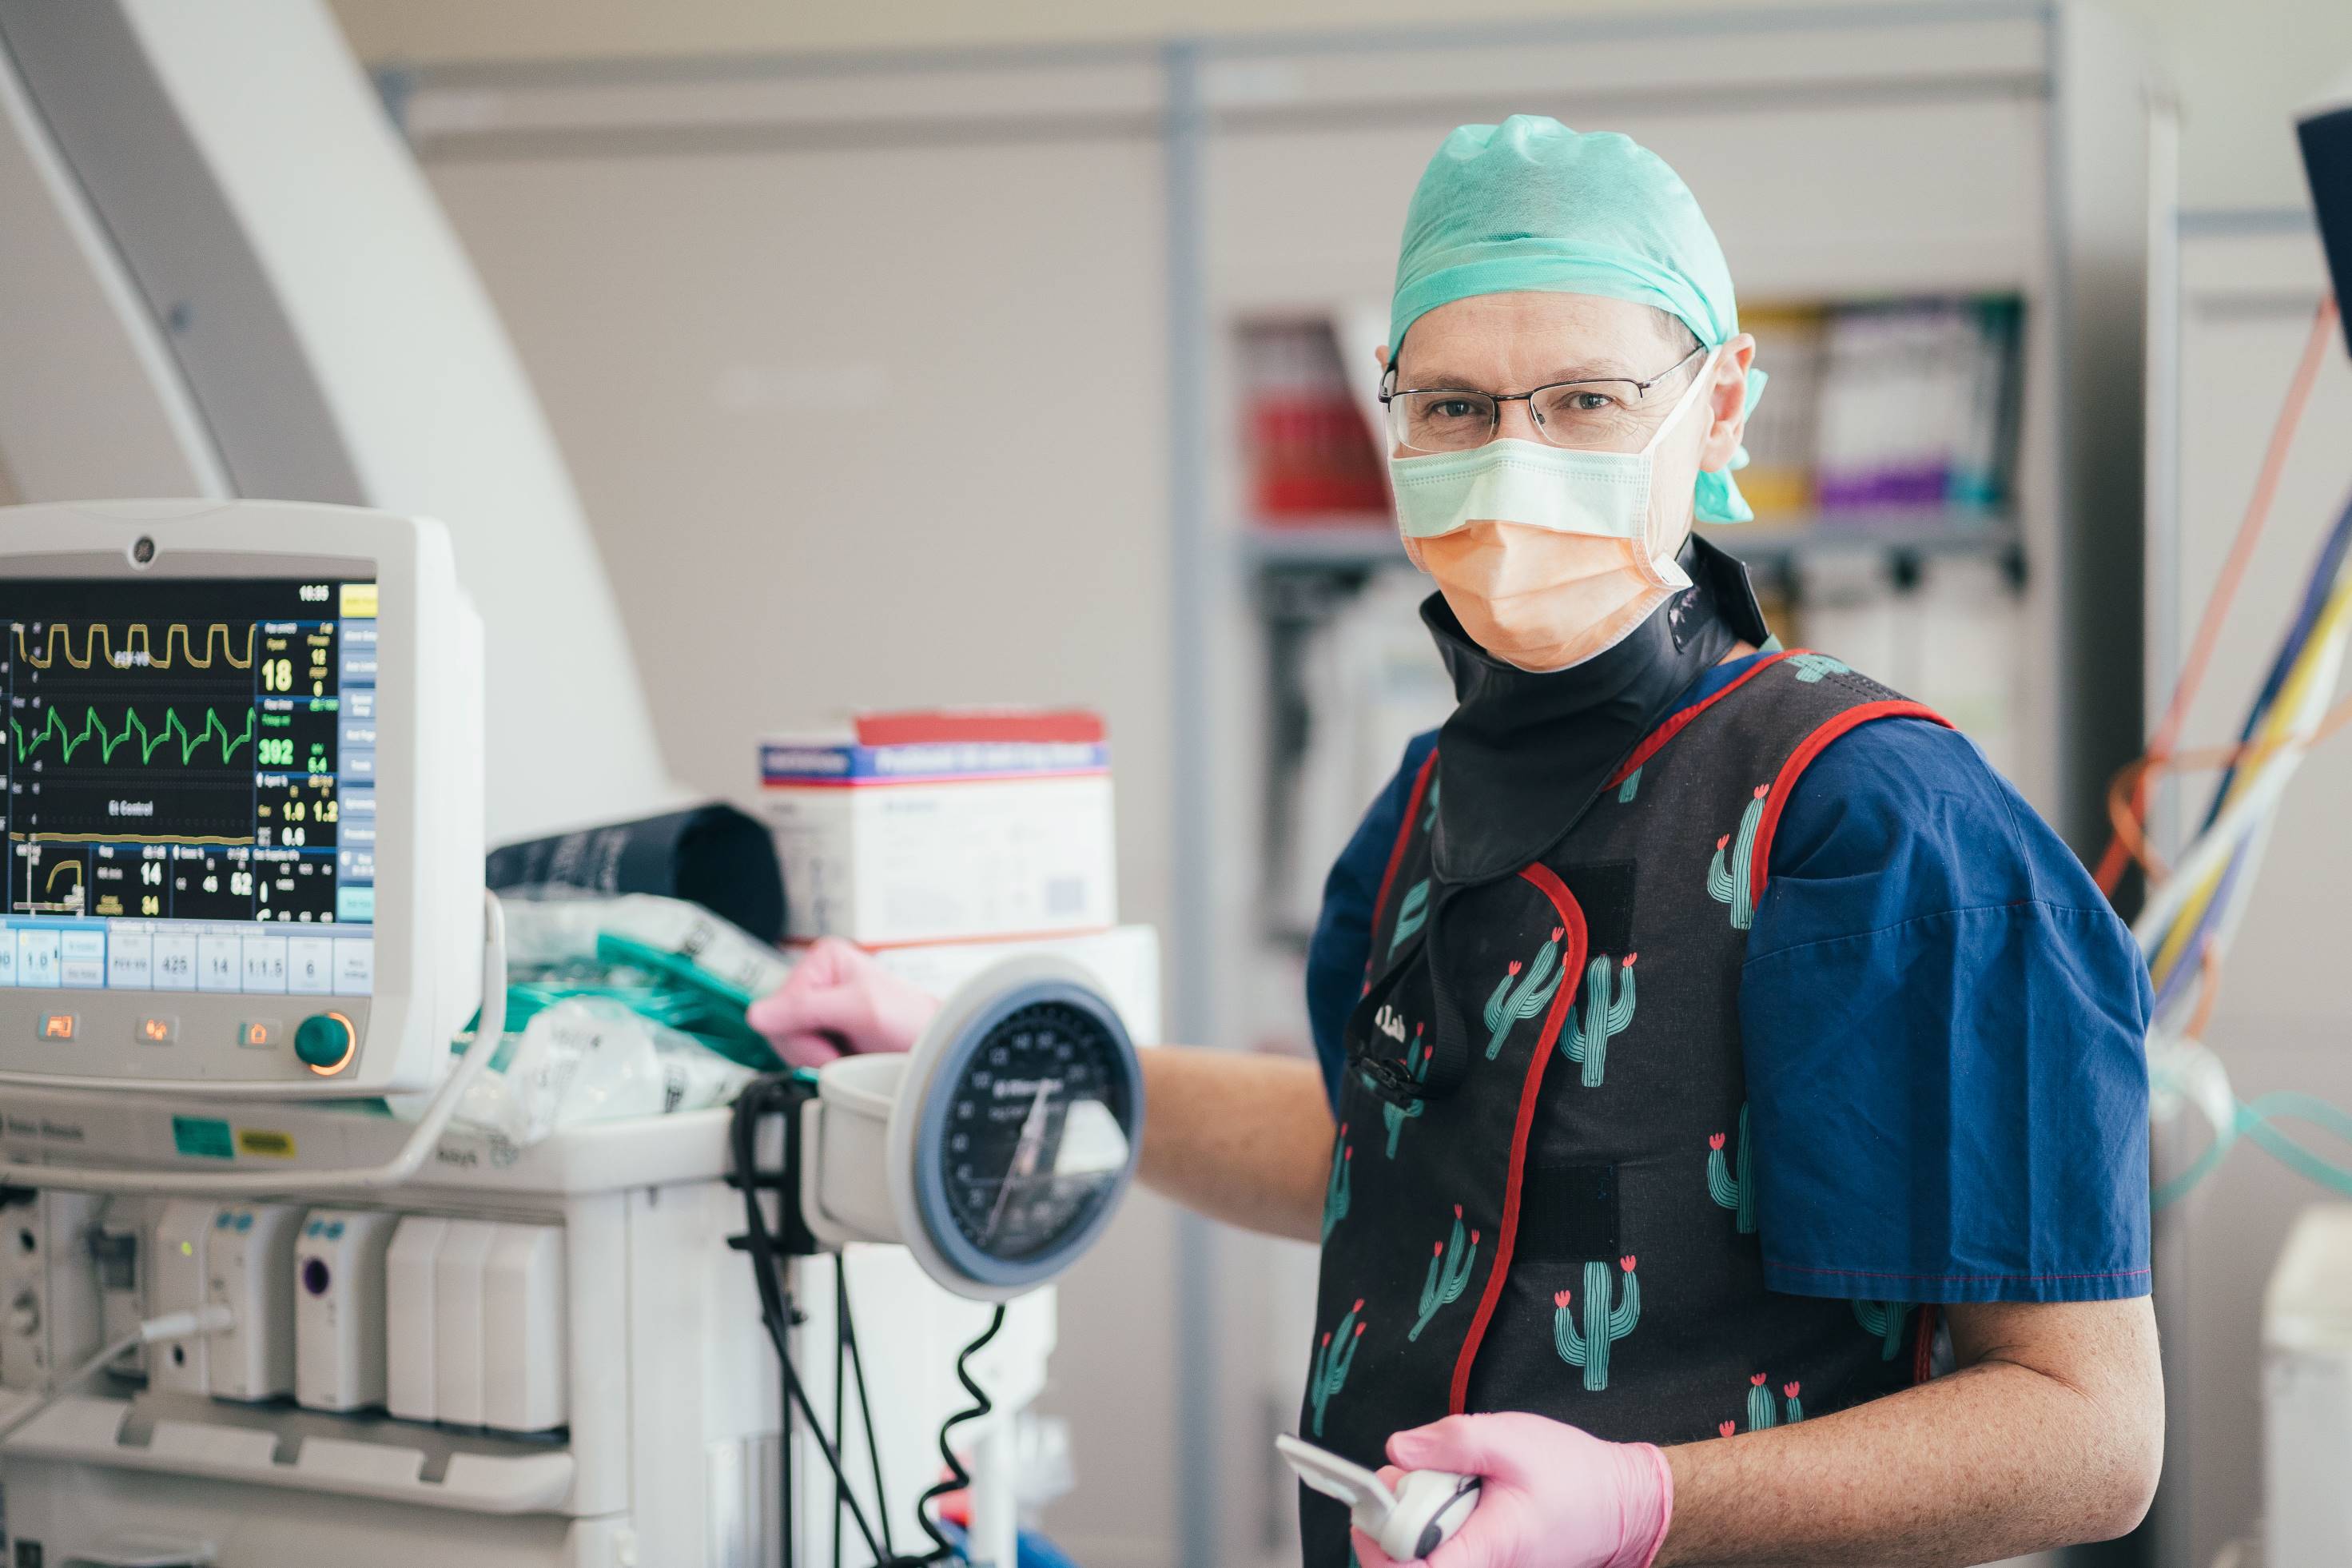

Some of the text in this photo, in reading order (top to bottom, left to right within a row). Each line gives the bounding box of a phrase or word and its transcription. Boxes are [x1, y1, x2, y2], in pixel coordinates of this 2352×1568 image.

[262, 659, 293, 691] 18
[141, 862, 161, 885] 14
[213, 957, 228, 974] 14
